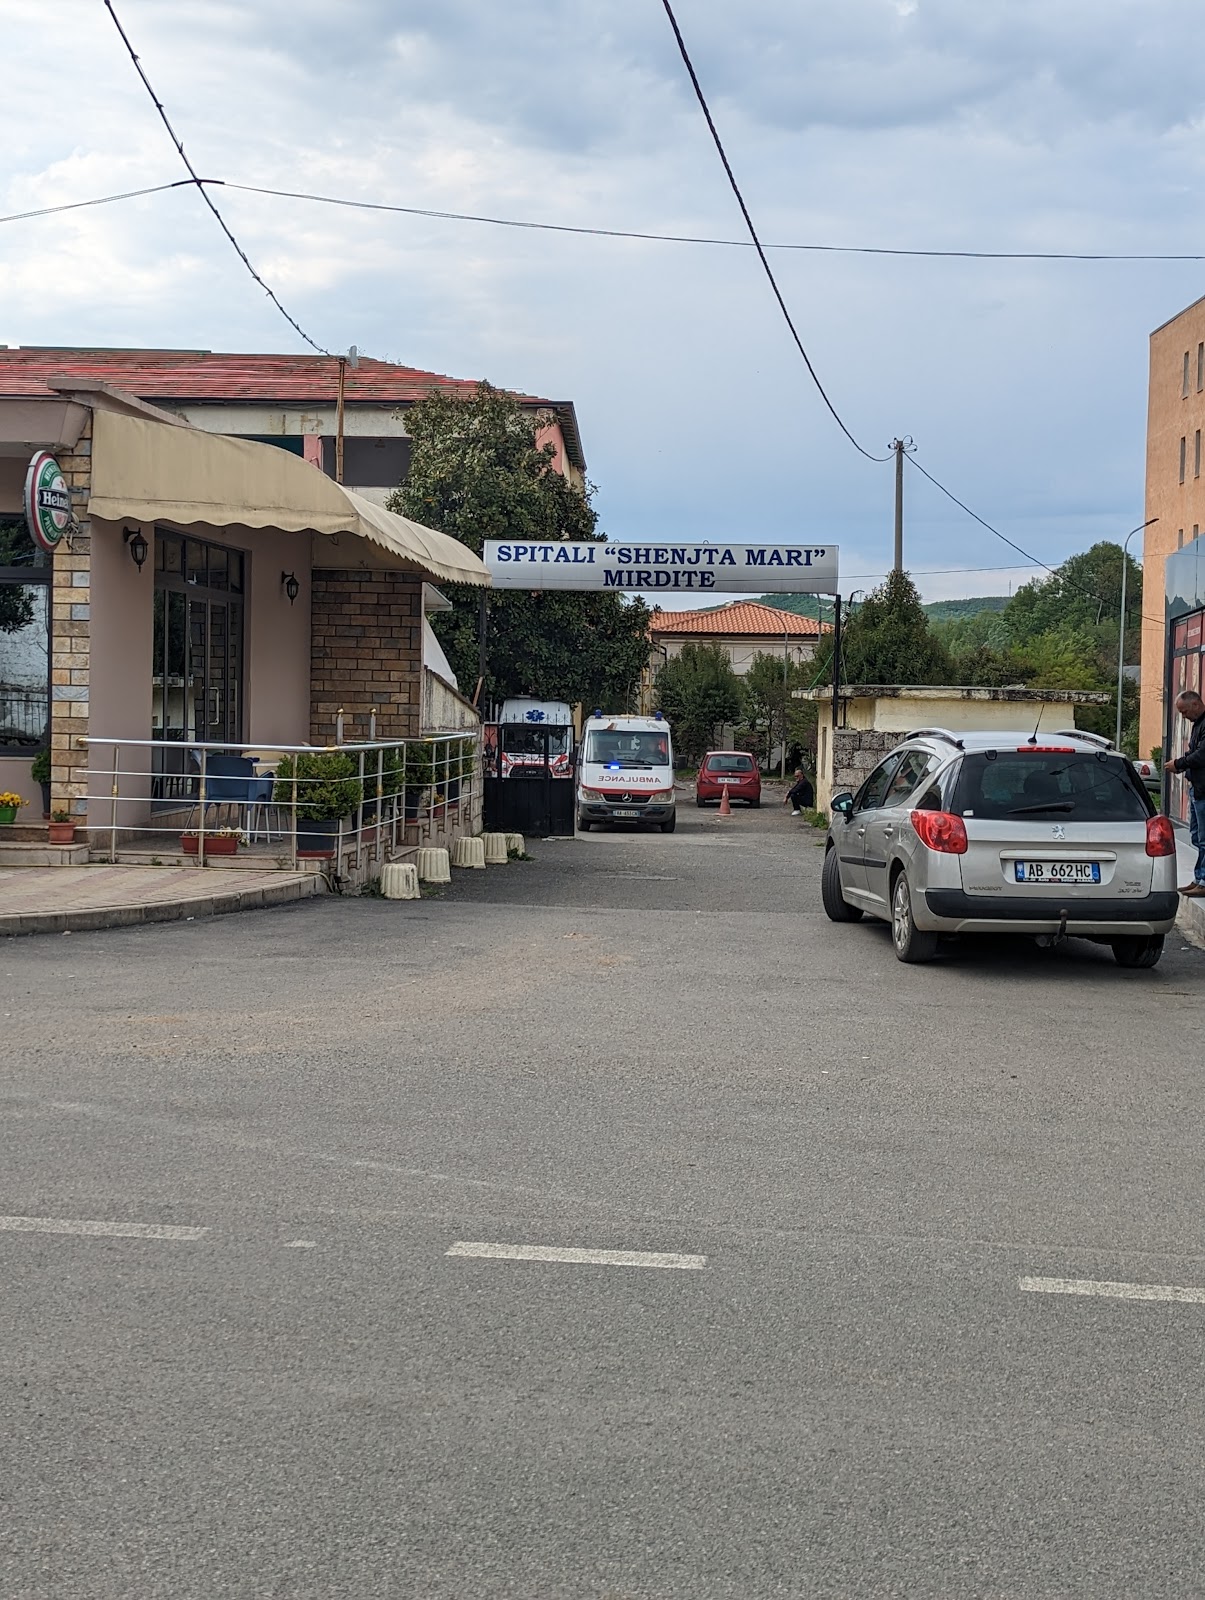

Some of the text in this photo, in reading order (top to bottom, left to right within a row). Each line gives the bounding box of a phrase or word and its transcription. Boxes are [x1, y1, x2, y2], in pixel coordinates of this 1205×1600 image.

[42, 491, 69, 507] Heine
[497, 545, 826, 566] SPITALI “SHENJTA MARI”
[603, 570, 716, 588] MIRDITE
[1028, 864, 1091, 878] AB 662 HC
